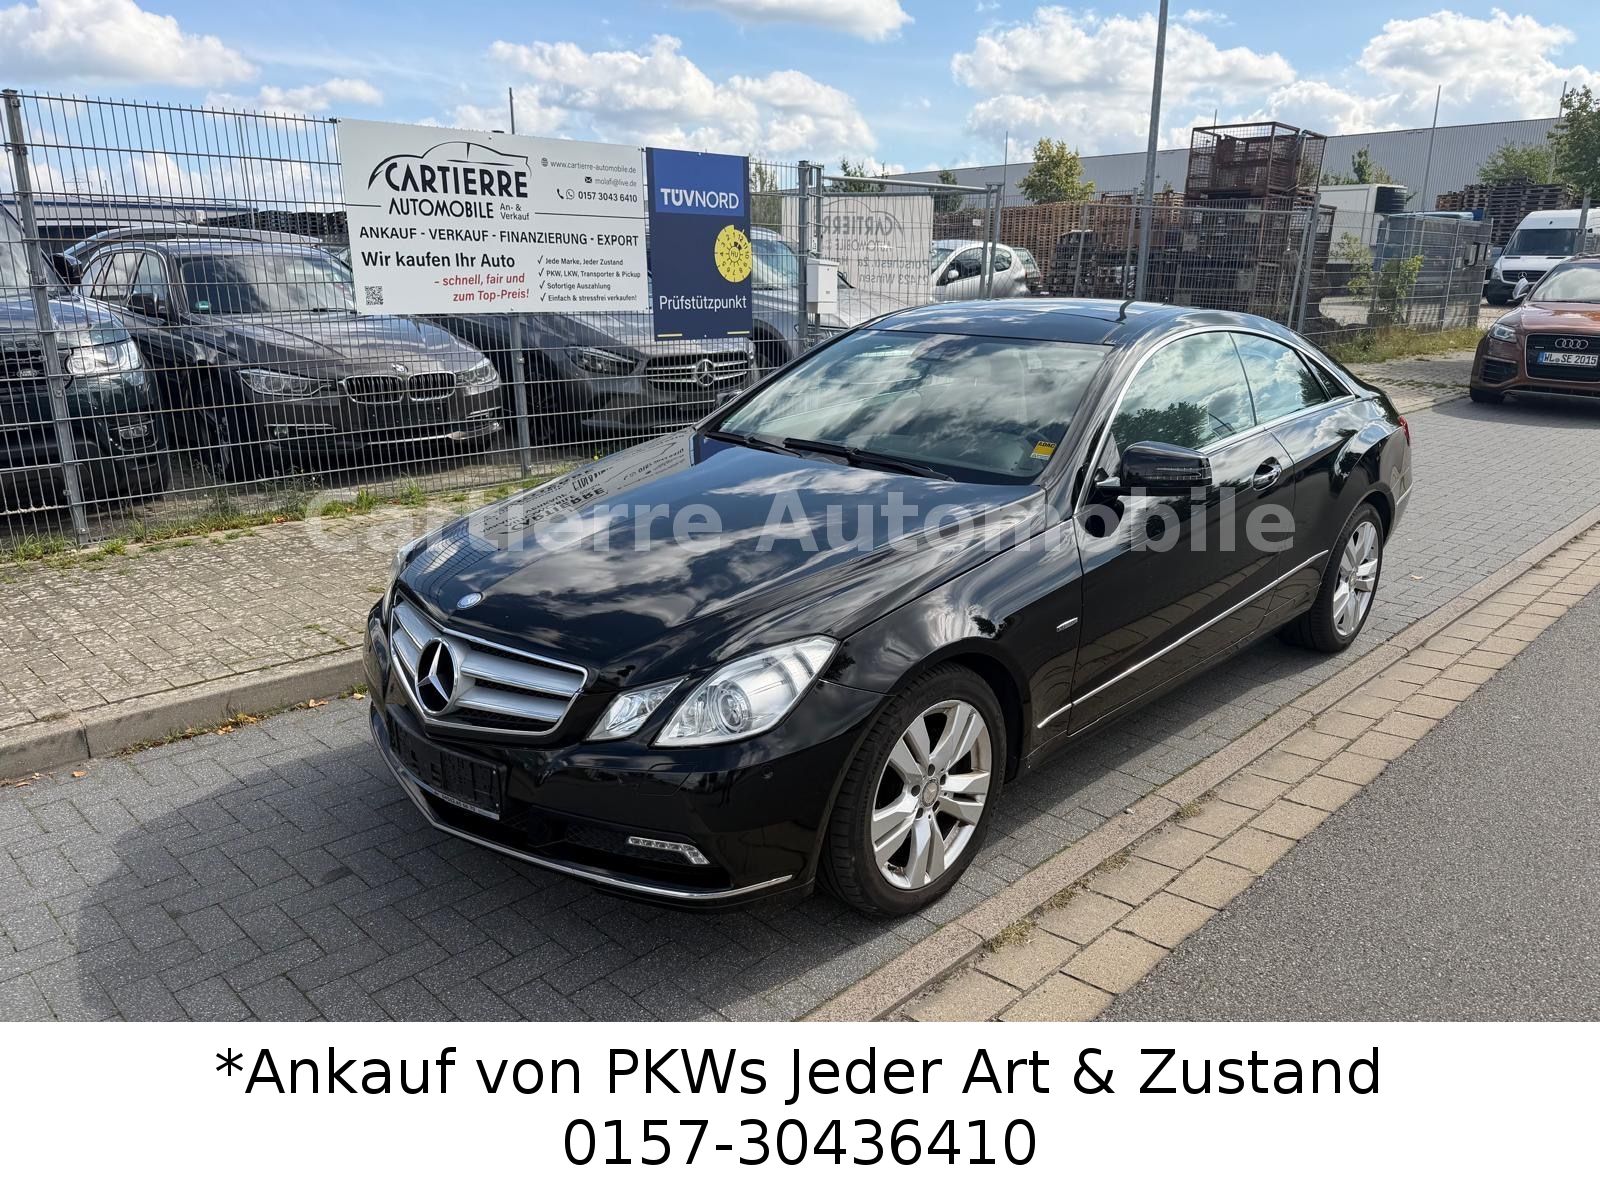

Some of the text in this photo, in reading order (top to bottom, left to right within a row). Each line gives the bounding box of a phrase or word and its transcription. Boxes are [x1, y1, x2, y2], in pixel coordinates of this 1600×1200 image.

[551, 160, 636, 174] www.cartierre-automobile.de
[385, 162, 528, 198] CARTIERRE
[578, 191, 638, 202] 0157 3043 6410
[389, 198, 494, 219] AUTOMOBILE
[500, 203, 514, 211] An-
[500, 212, 530, 220] Verkauf
[360, 227, 416, 239] ANKAUF
[429, 228, 488, 242] VERKAUF
[500, 231, 587, 244] FINANZIERUNG
[597, 234, 638, 246] EXPORT
[361, 251, 515, 268] Wir kaufen Ihr Auto
[561, 258, 581, 266] Marke,
[583, 258, 598, 266] Jeder
[600, 258, 623, 266] Zustand
[442, 274, 484, 287] schnell,
[486, 274, 504, 284] fair
[506, 274, 525, 284] und
[546, 270, 562, 278] PKW,
[564, 270, 579, 278] LKW,
[580, 270, 614, 279] Transporter
[622, 271, 640, 279] Pickup
[547, 282, 611, 290] Sofortige Auszahlung
[453, 289, 529, 302] zum Top-Preis!
[548, 294, 570, 302] Einfach
[660, 294, 746, 312] Prüfstützpunkt
[1561, 355, 1573, 363] SE
[1575, 356, 1597, 364] 2015
